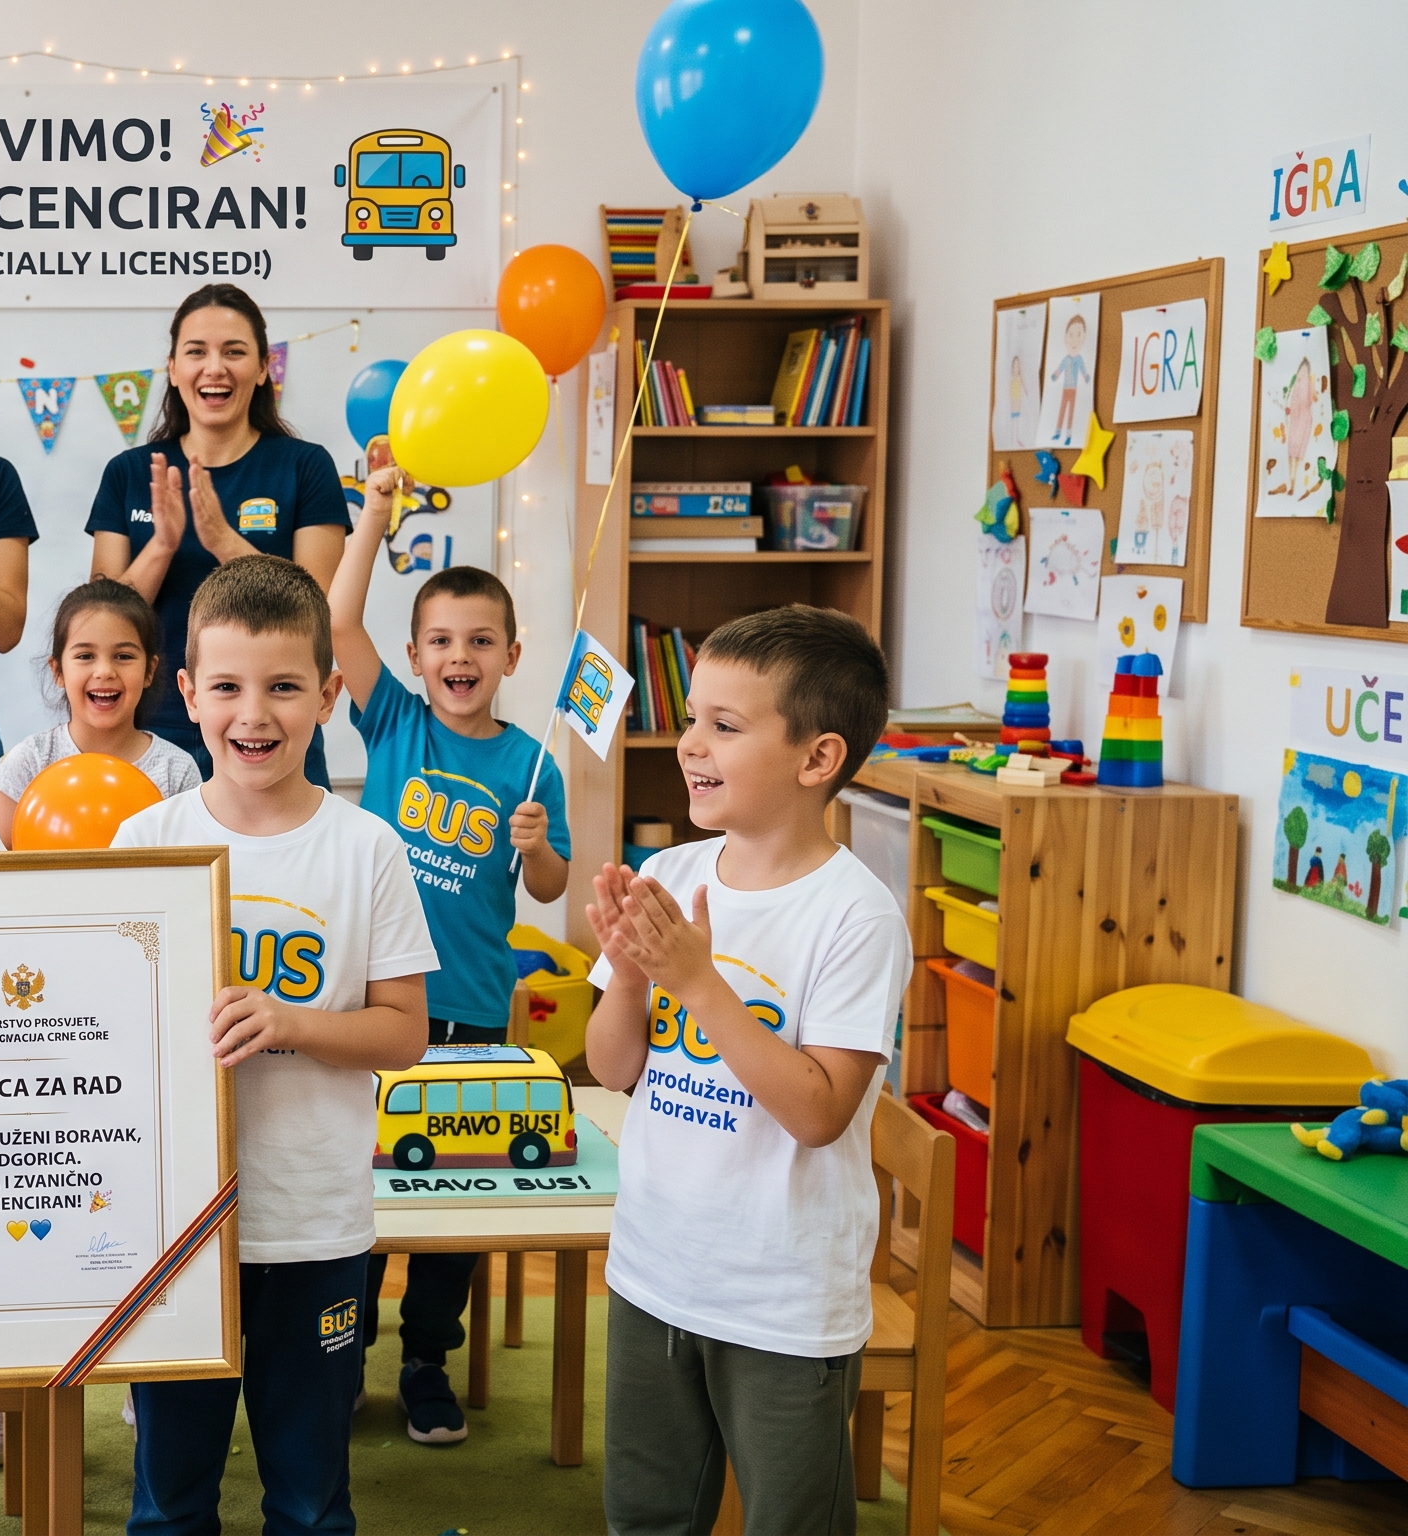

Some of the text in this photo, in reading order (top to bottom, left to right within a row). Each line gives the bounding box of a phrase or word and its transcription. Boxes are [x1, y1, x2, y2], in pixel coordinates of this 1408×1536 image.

[101, 249, 273, 280] LICENSED!)
[1132, 326, 1199, 397] IGRA
[35, 388, 59, 415] N
[114, 379, 140, 407] A
[130, 509, 154, 522] Ma
[398, 777, 499, 858] BUS
[404, 841, 477, 879] roduženi
[409, 864, 462, 895] oravak
[231, 927, 325, 1003] US
[34, 1016, 100, 1028] PROSVJETE,
[47, 1032, 76, 1042] CRNE
[79, 1030, 110, 1041] GORE
[35, 1076, 67, 1096] ZA
[73, 1075, 122, 1095] RAD
[647, 1068, 754, 1108] produženi
[427, 1113, 560, 1137] BRAVO BUS!
[650, 1090, 737, 1133] boravak
[55, 1127, 142, 1145] BORAVAK,
[4, 1175, 9, 1189] I
[14, 1170, 103, 1189] ZVANIČNO
[389, 1175, 592, 1192] BRAVO BUS!
[319, 1304, 358, 1338] BUS
